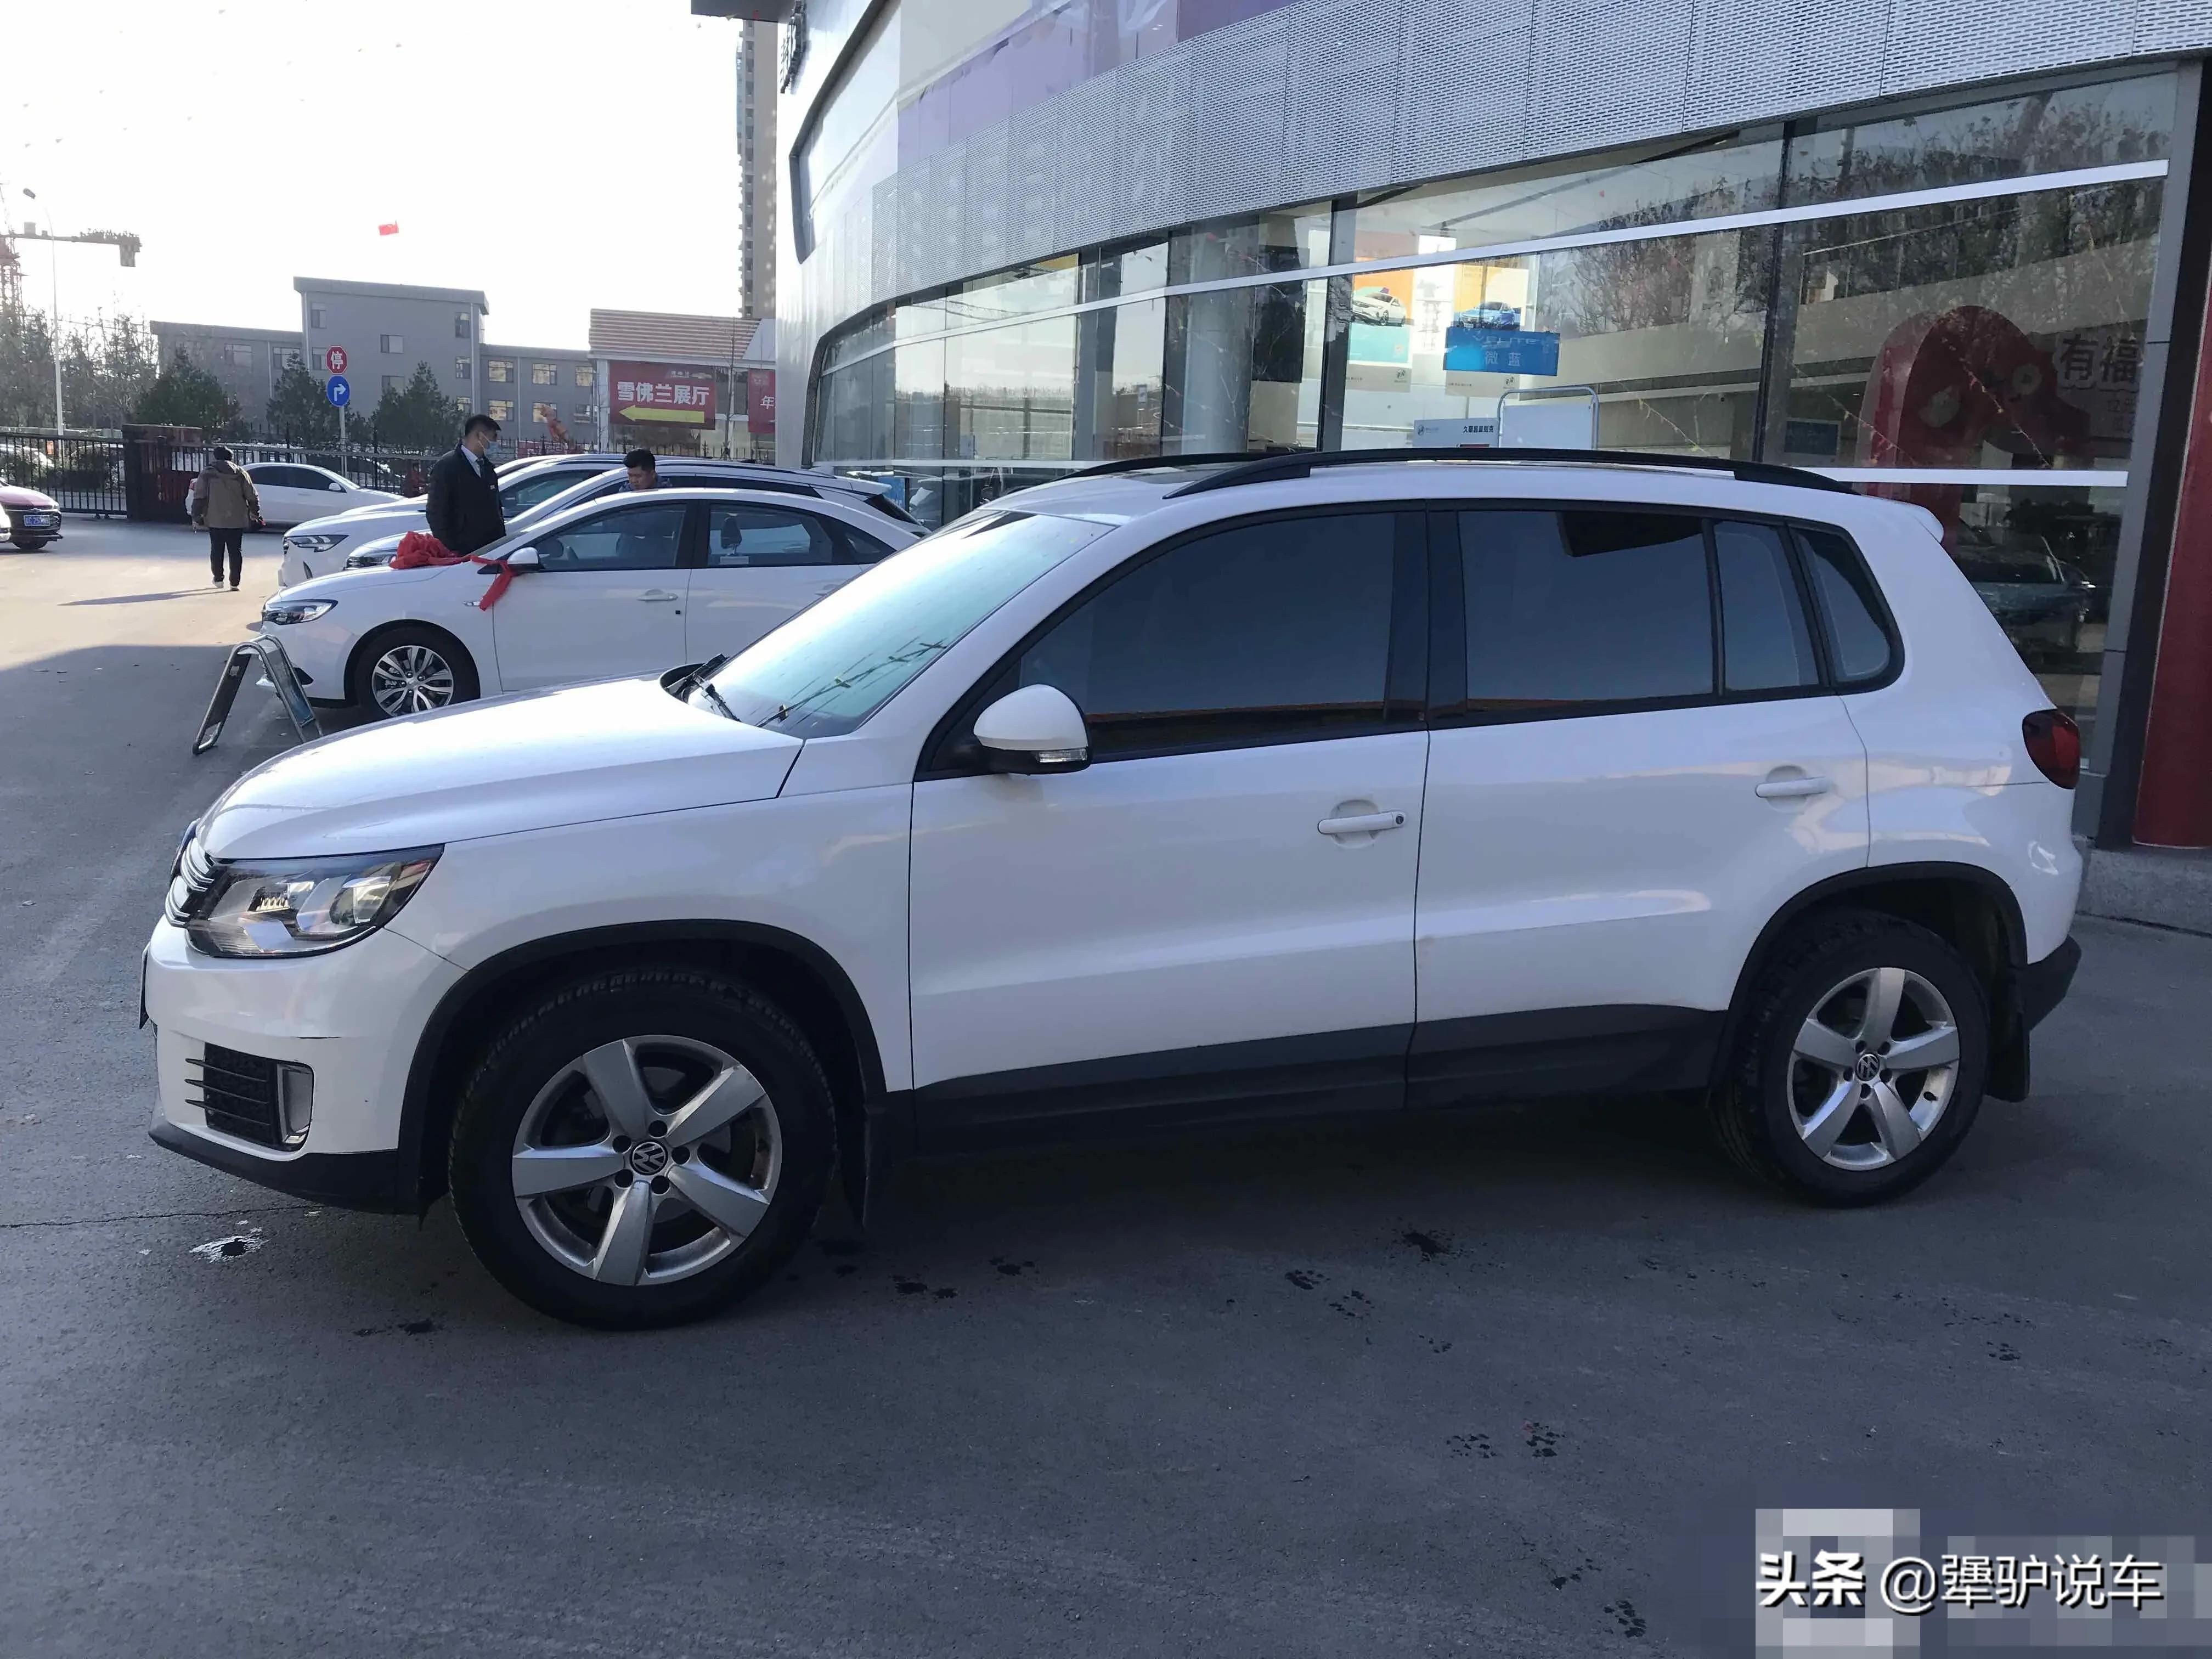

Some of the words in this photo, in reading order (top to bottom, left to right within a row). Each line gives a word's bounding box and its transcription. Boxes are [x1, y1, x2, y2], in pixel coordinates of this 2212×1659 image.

[618, 381, 709, 405] 雪佛兰展厅
[760, 395, 775, 409] 年
